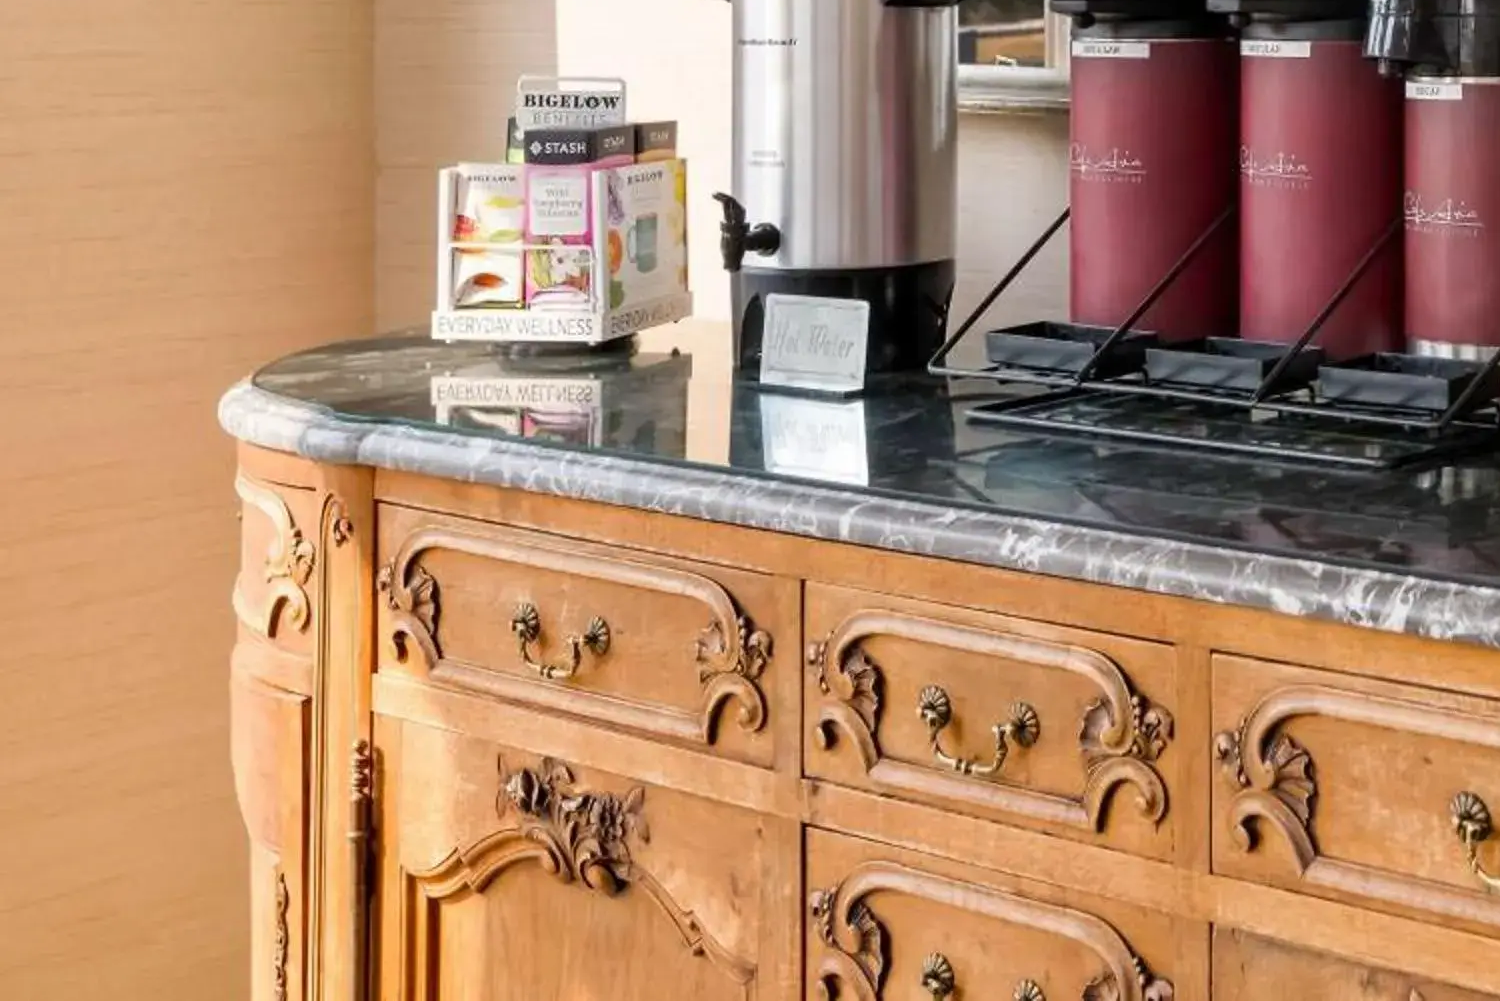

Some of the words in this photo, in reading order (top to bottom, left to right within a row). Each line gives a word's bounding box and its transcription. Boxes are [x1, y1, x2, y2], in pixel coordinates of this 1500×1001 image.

[524, 94, 620, 109] BIGELOW
[544, 142, 587, 154] STASH
[437, 316, 514, 334] EVERYDAY
[517, 317, 594, 336] WELLNESS
